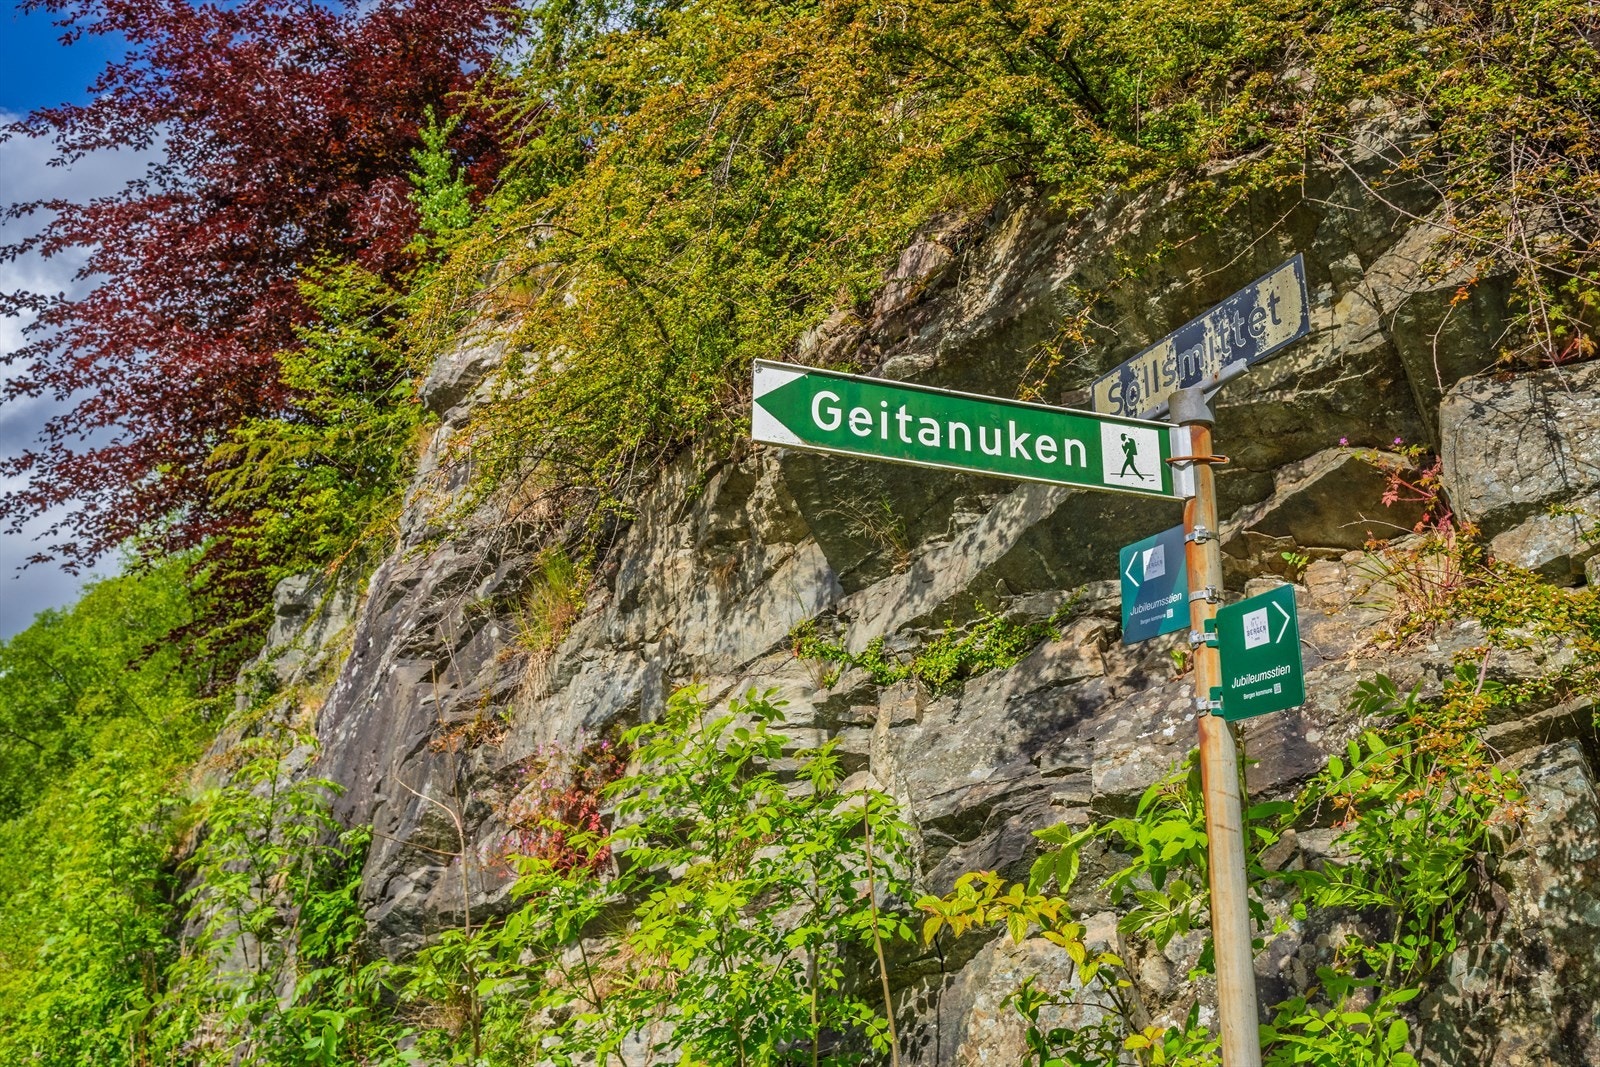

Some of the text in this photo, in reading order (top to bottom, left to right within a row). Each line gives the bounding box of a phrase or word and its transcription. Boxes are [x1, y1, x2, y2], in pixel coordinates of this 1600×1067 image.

[1107, 289, 1282, 416] Sollsmittet
[811, 390, 1087, 468] Geitanuken
[1130, 592, 1182, 616] Jubileumsstien
[1231, 664, 1291, 689] Jubileumsstien
[1243, 688, 1273, 700] Bergen kommune
